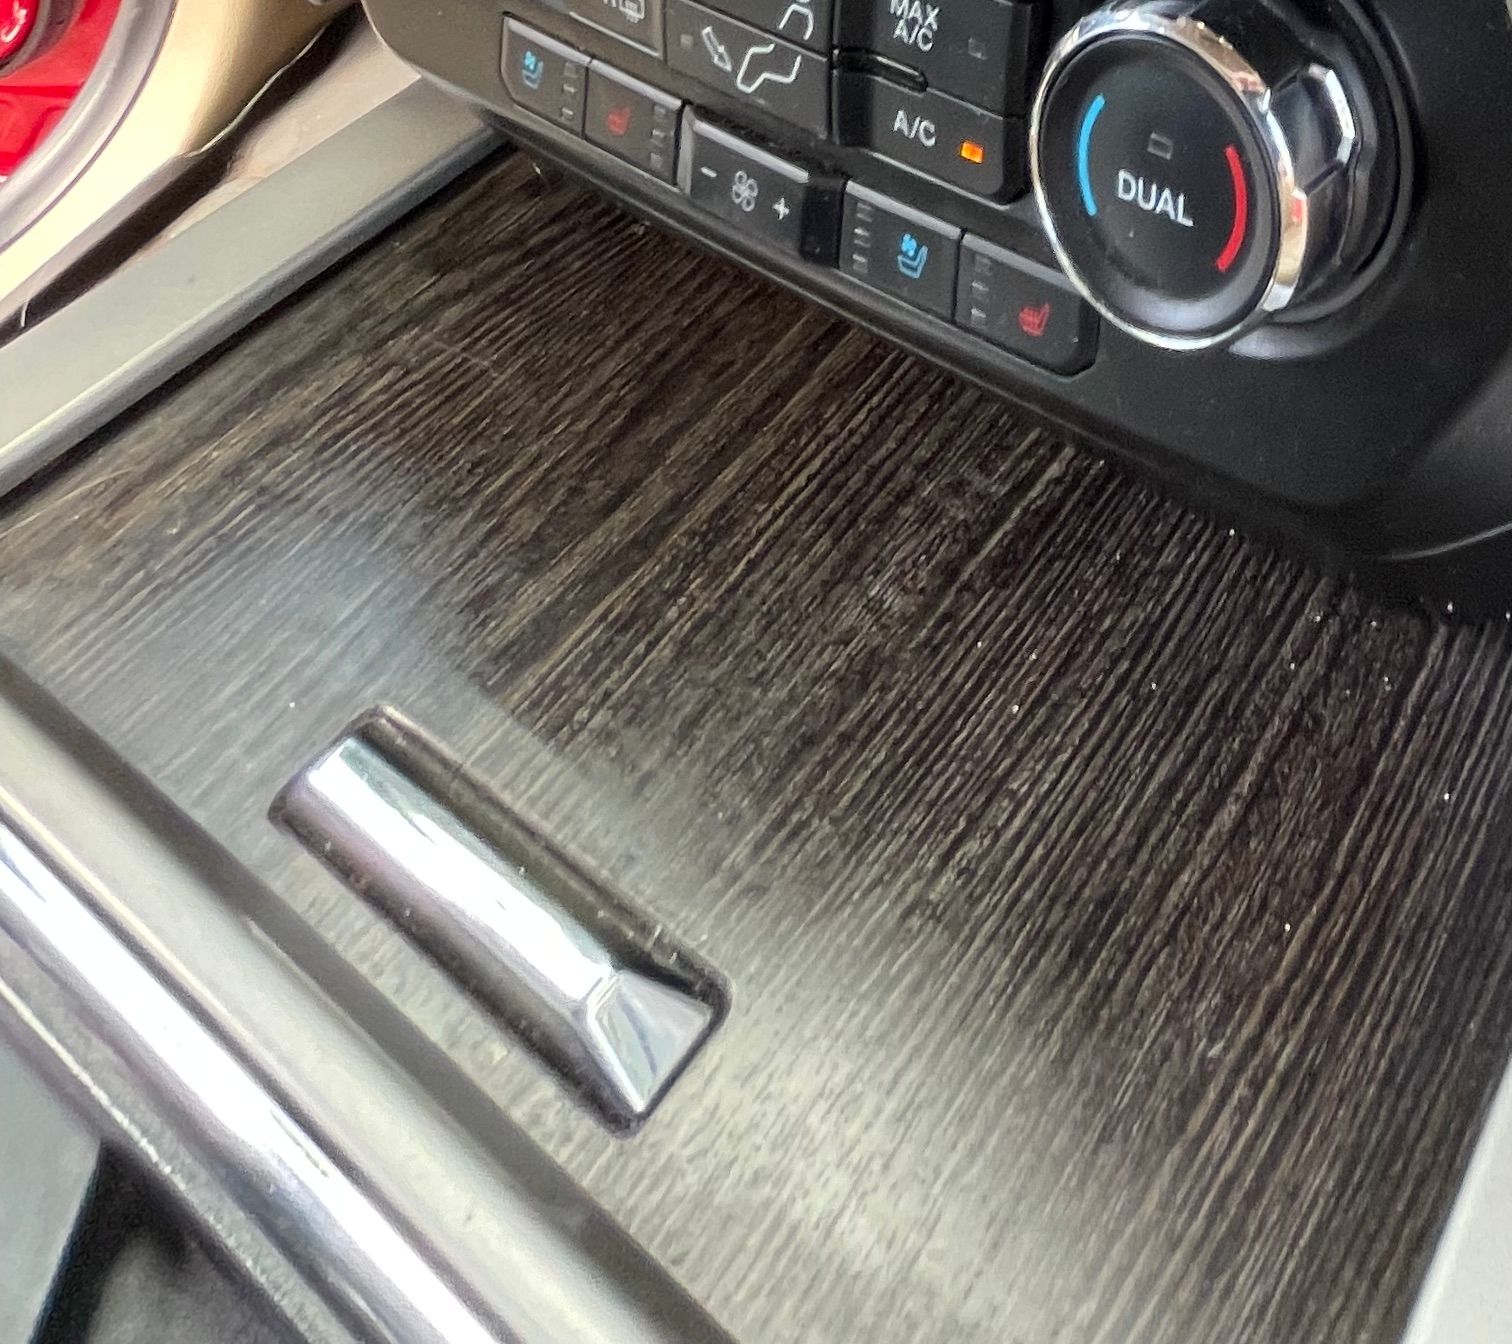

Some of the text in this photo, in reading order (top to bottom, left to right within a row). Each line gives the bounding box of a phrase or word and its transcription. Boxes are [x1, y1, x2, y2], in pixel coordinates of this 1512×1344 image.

[893, 16, 938, 53] A/C
[893, 109, 936, 147] A/C
[1117, 169, 1195, 227] DUAL
